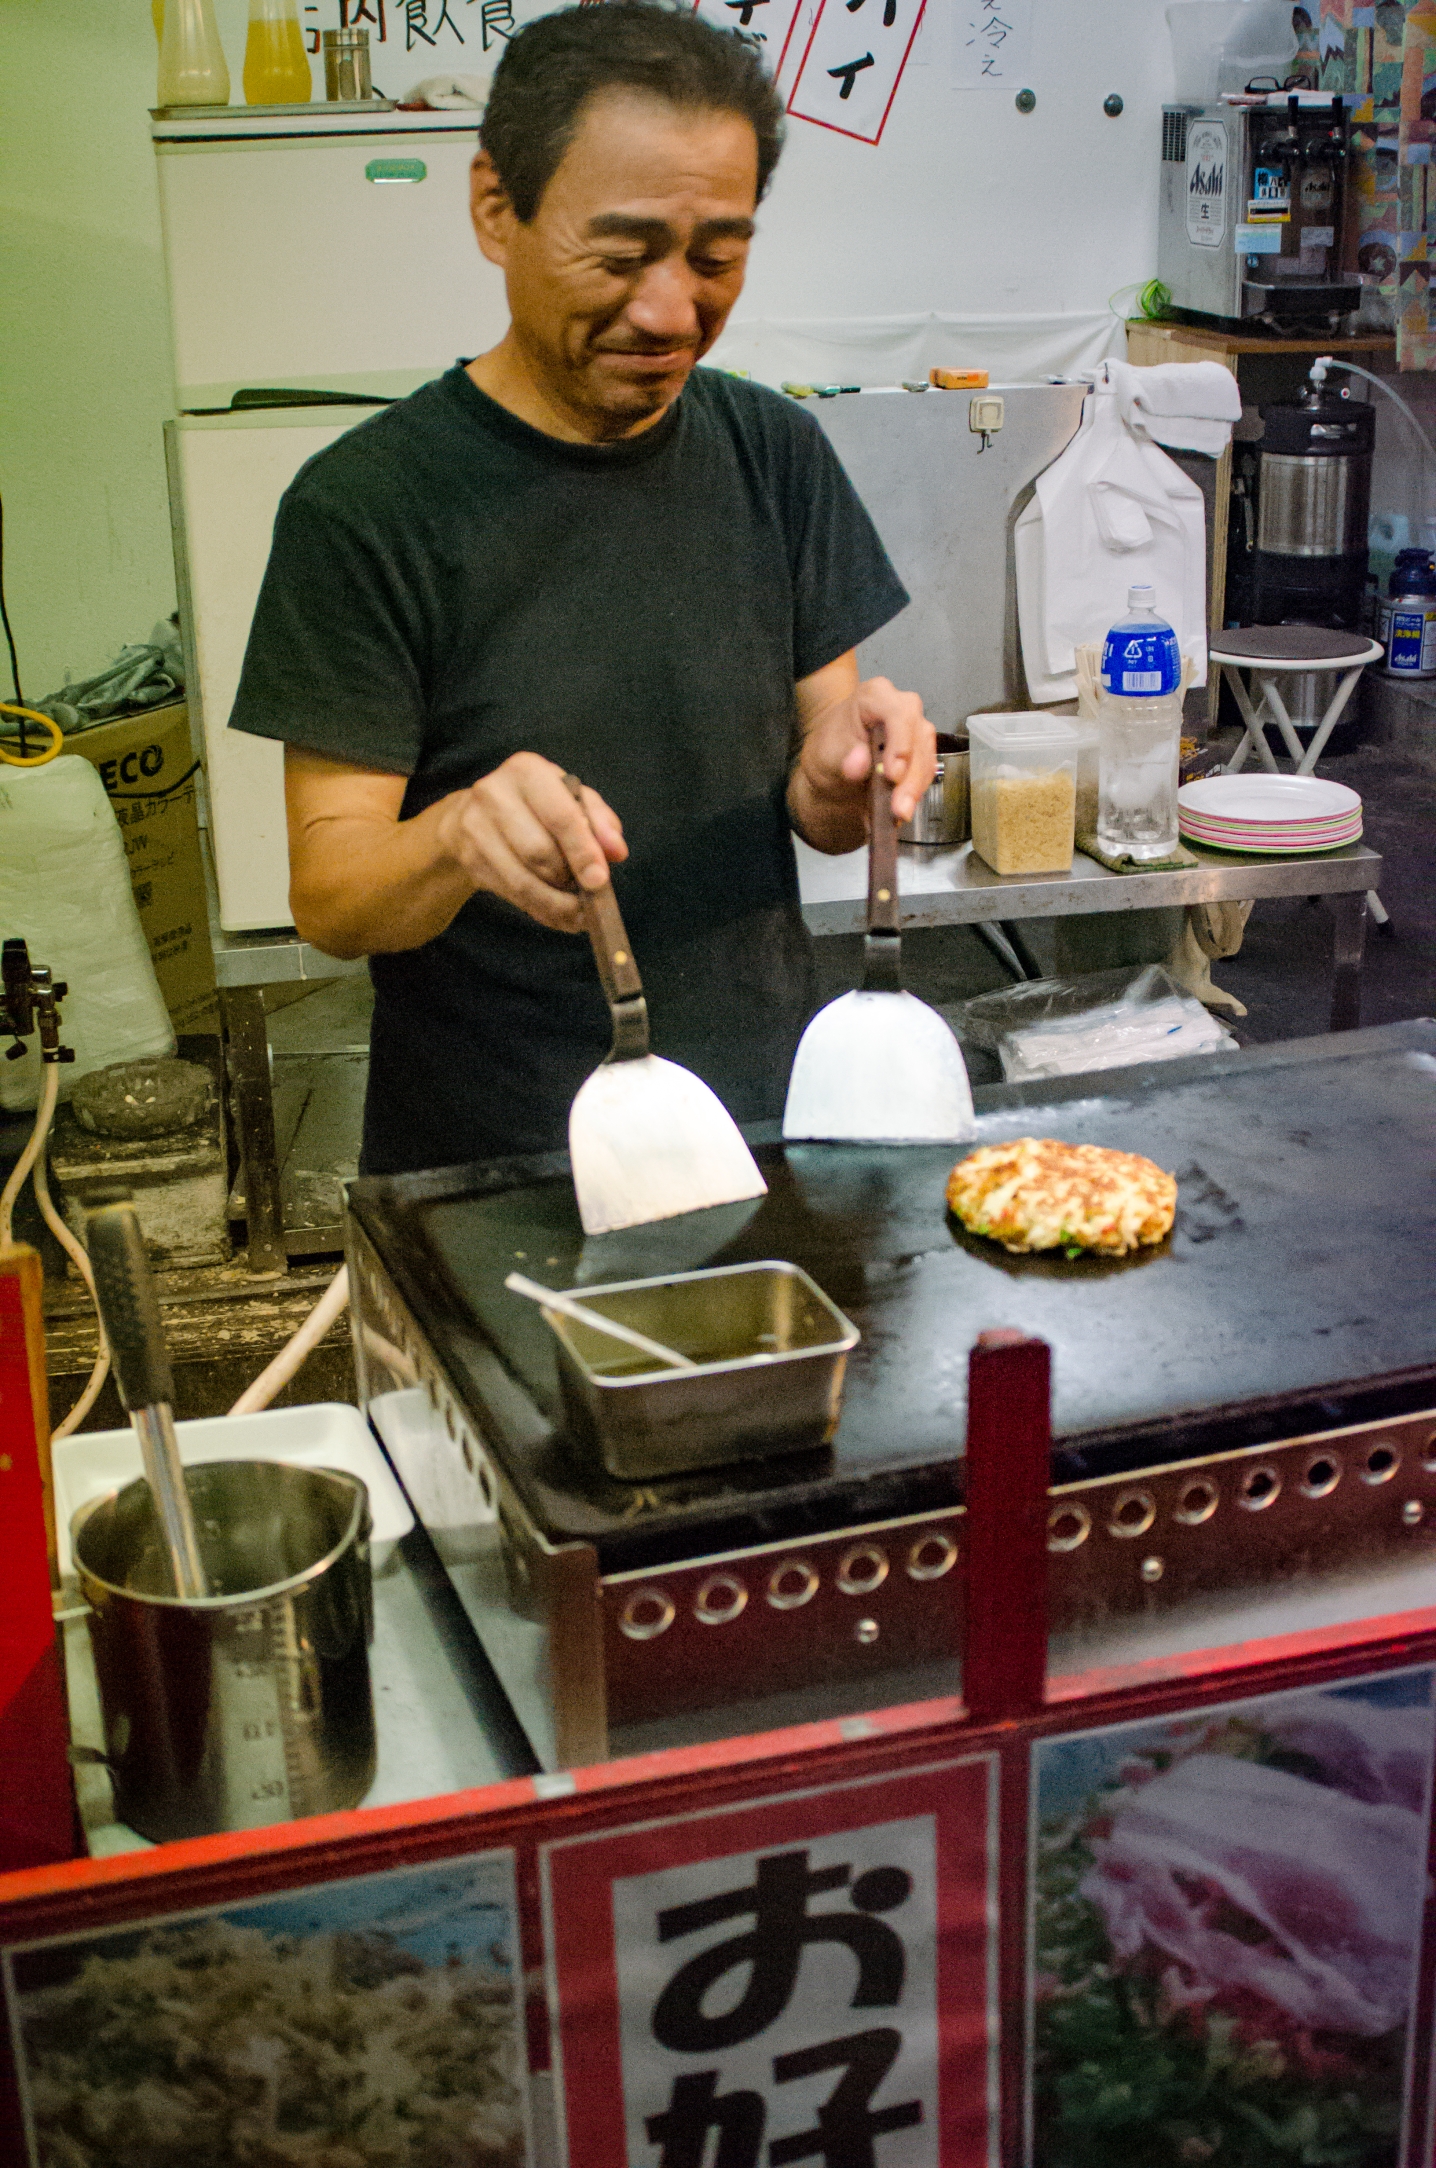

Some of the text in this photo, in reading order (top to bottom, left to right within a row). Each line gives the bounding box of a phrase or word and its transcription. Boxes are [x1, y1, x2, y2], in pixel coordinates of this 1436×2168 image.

[304, 0, 516, 52] 内飲食
[1189, 162, 1224, 197] Asahi
[1201, 202, 1210, 220] 生
[1394, 653, 1418, 663] Asahi
[98, 744, 165, 791] ECO
[644, 1849, 925, 2168] お好
